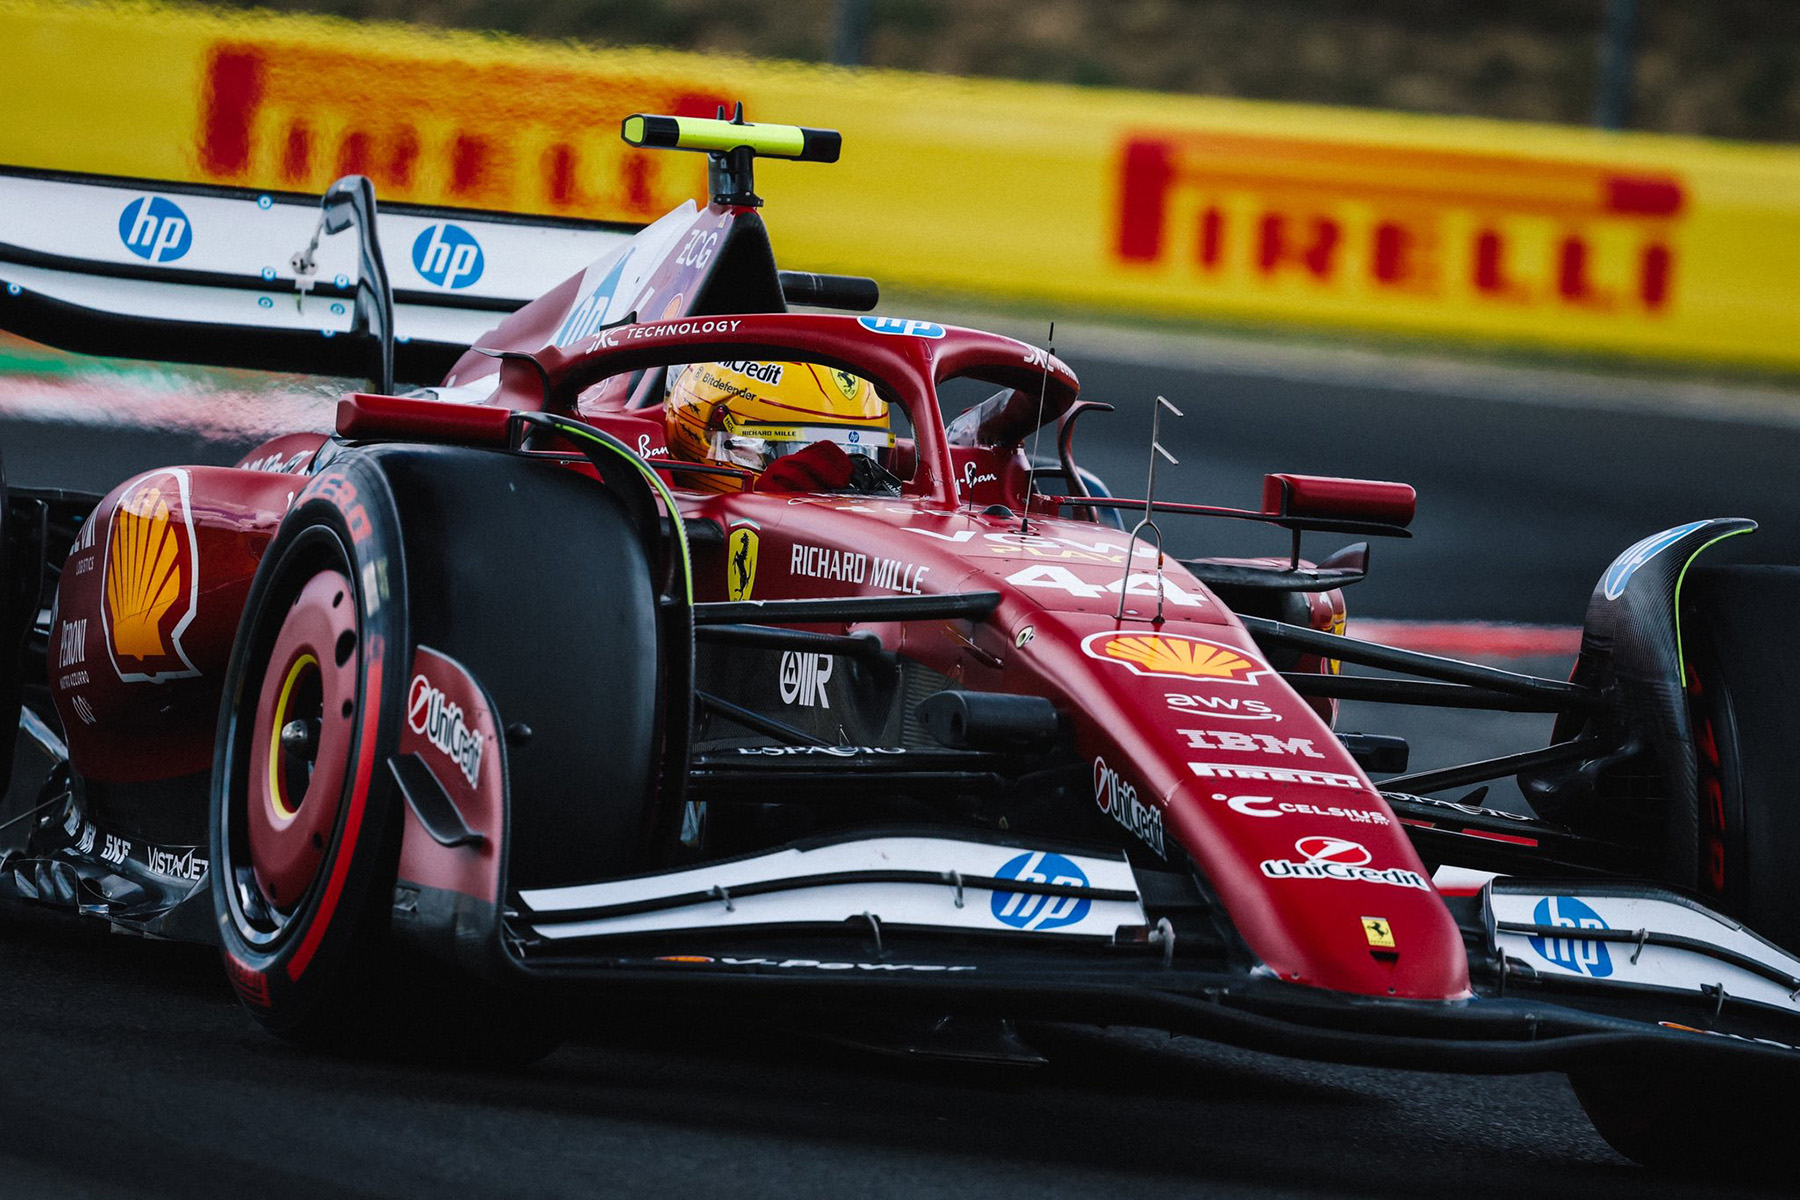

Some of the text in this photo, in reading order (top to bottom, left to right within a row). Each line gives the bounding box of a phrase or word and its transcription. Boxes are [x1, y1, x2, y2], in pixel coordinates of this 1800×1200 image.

[126, 196, 186, 261] hp
[418, 225, 477, 289] hp
[627, 320, 742, 339] TECHNOLOGY
[702, 372, 757, 401] Bitdefender
[790, 543, 930, 595] RICHARD MILLE
[1004, 565, 1209, 607] 44
[1164, 693, 1273, 714] aws
[1176, 728, 1325, 759] IBM
[1187, 762, 1363, 790] PIRELLI
[1278, 802, 1387, 822] CELSIUS
[100, 833, 131, 865] SKF
[999, 851, 1084, 930] hp
[1261, 859, 1429, 891] UniCredit
[1543, 896, 1607, 976] hp
